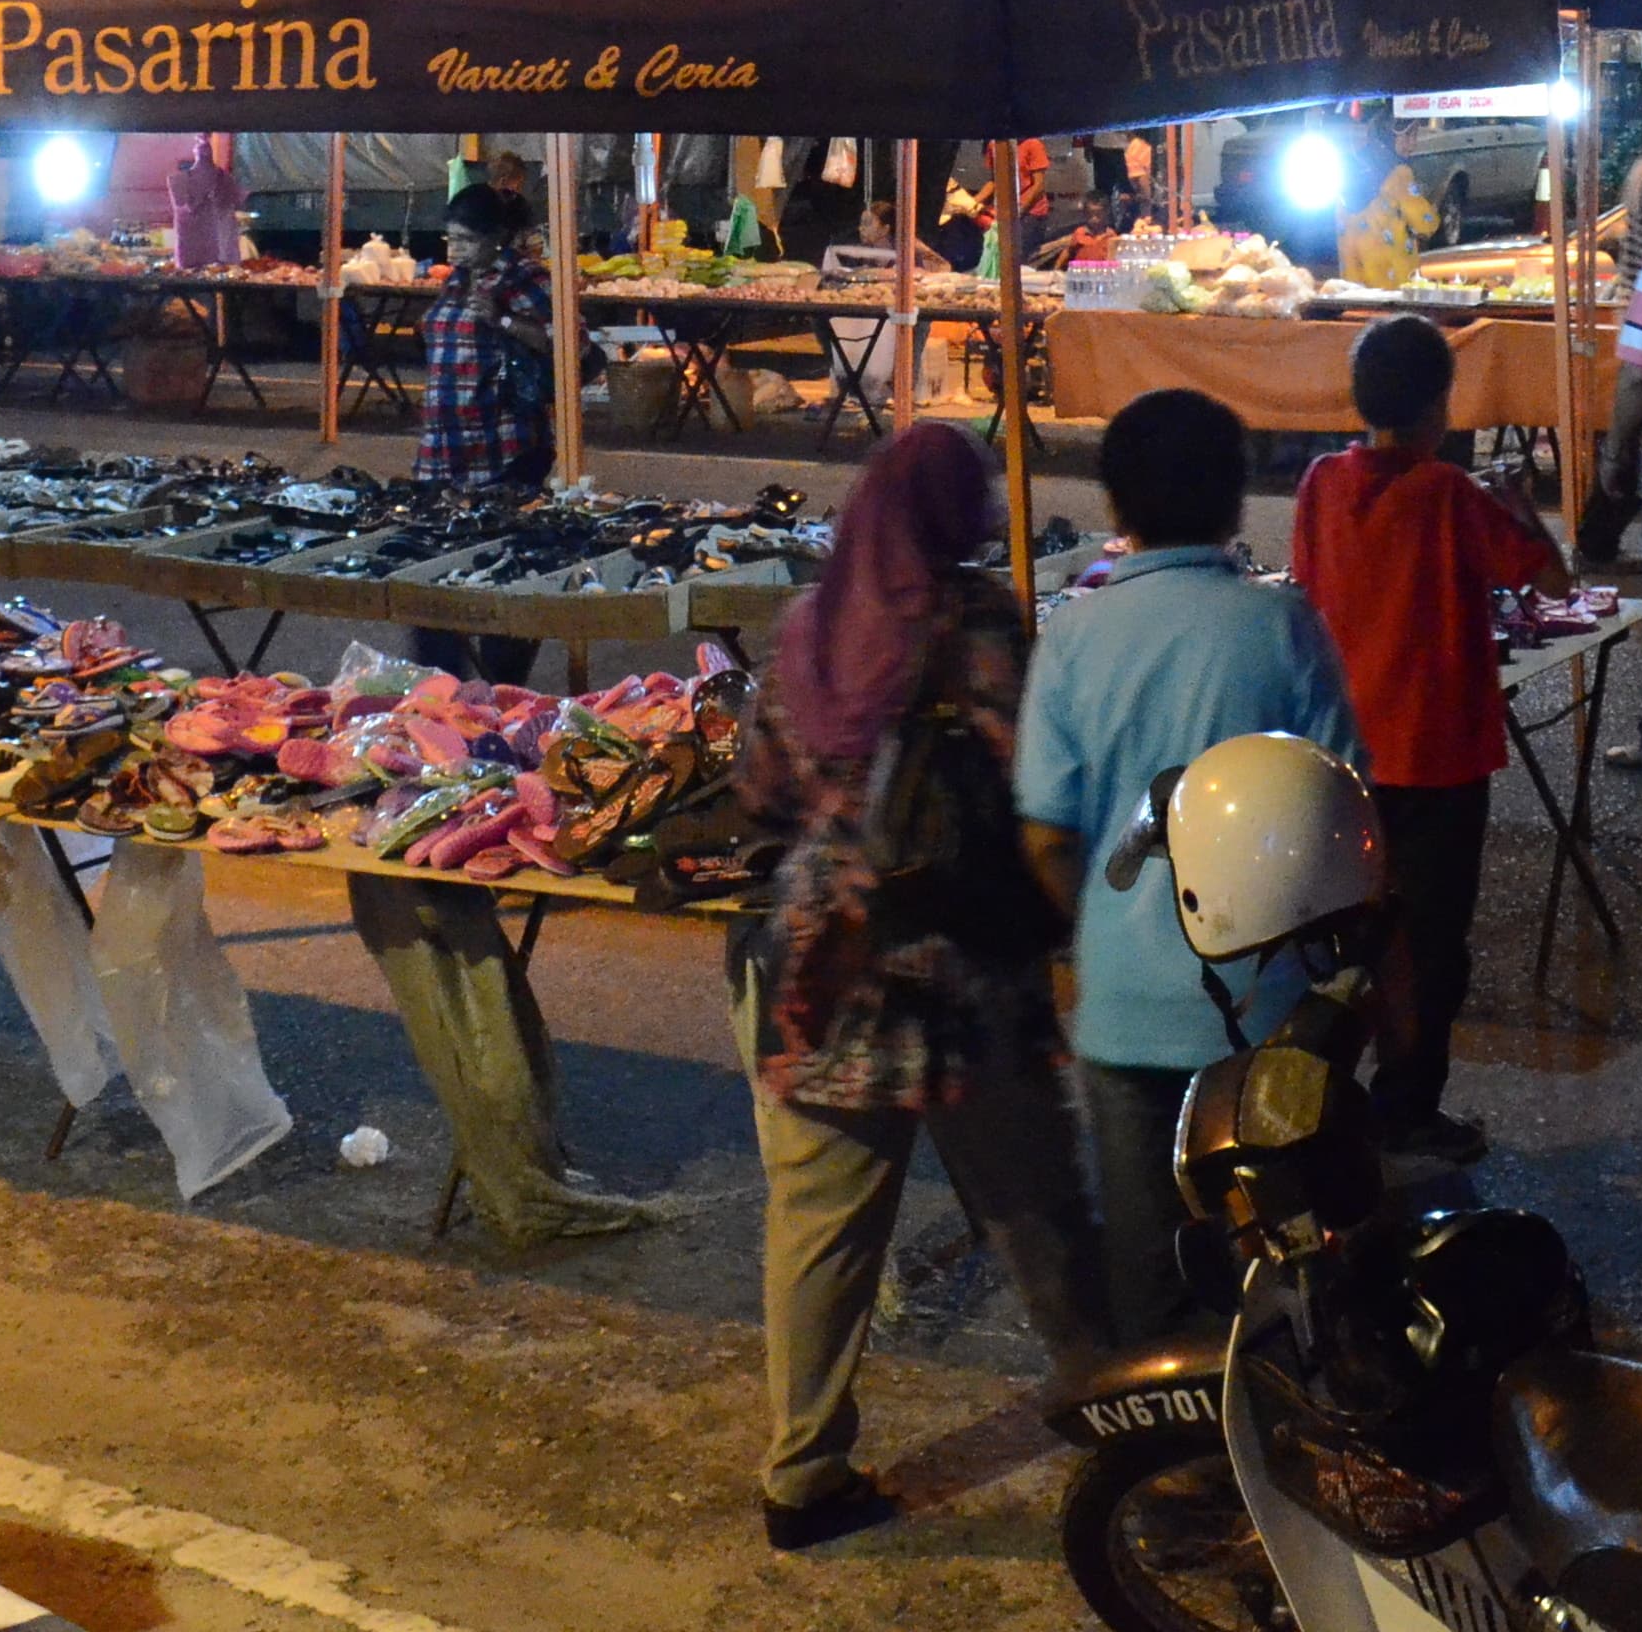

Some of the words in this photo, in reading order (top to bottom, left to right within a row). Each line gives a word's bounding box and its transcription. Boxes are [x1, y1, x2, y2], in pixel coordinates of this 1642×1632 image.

[427, 47, 570, 97] Varieti
[584, 45, 619, 89] &
[633, 43, 759, 99] Ceria
[1081, 1387, 1217, 1438] KV6701
